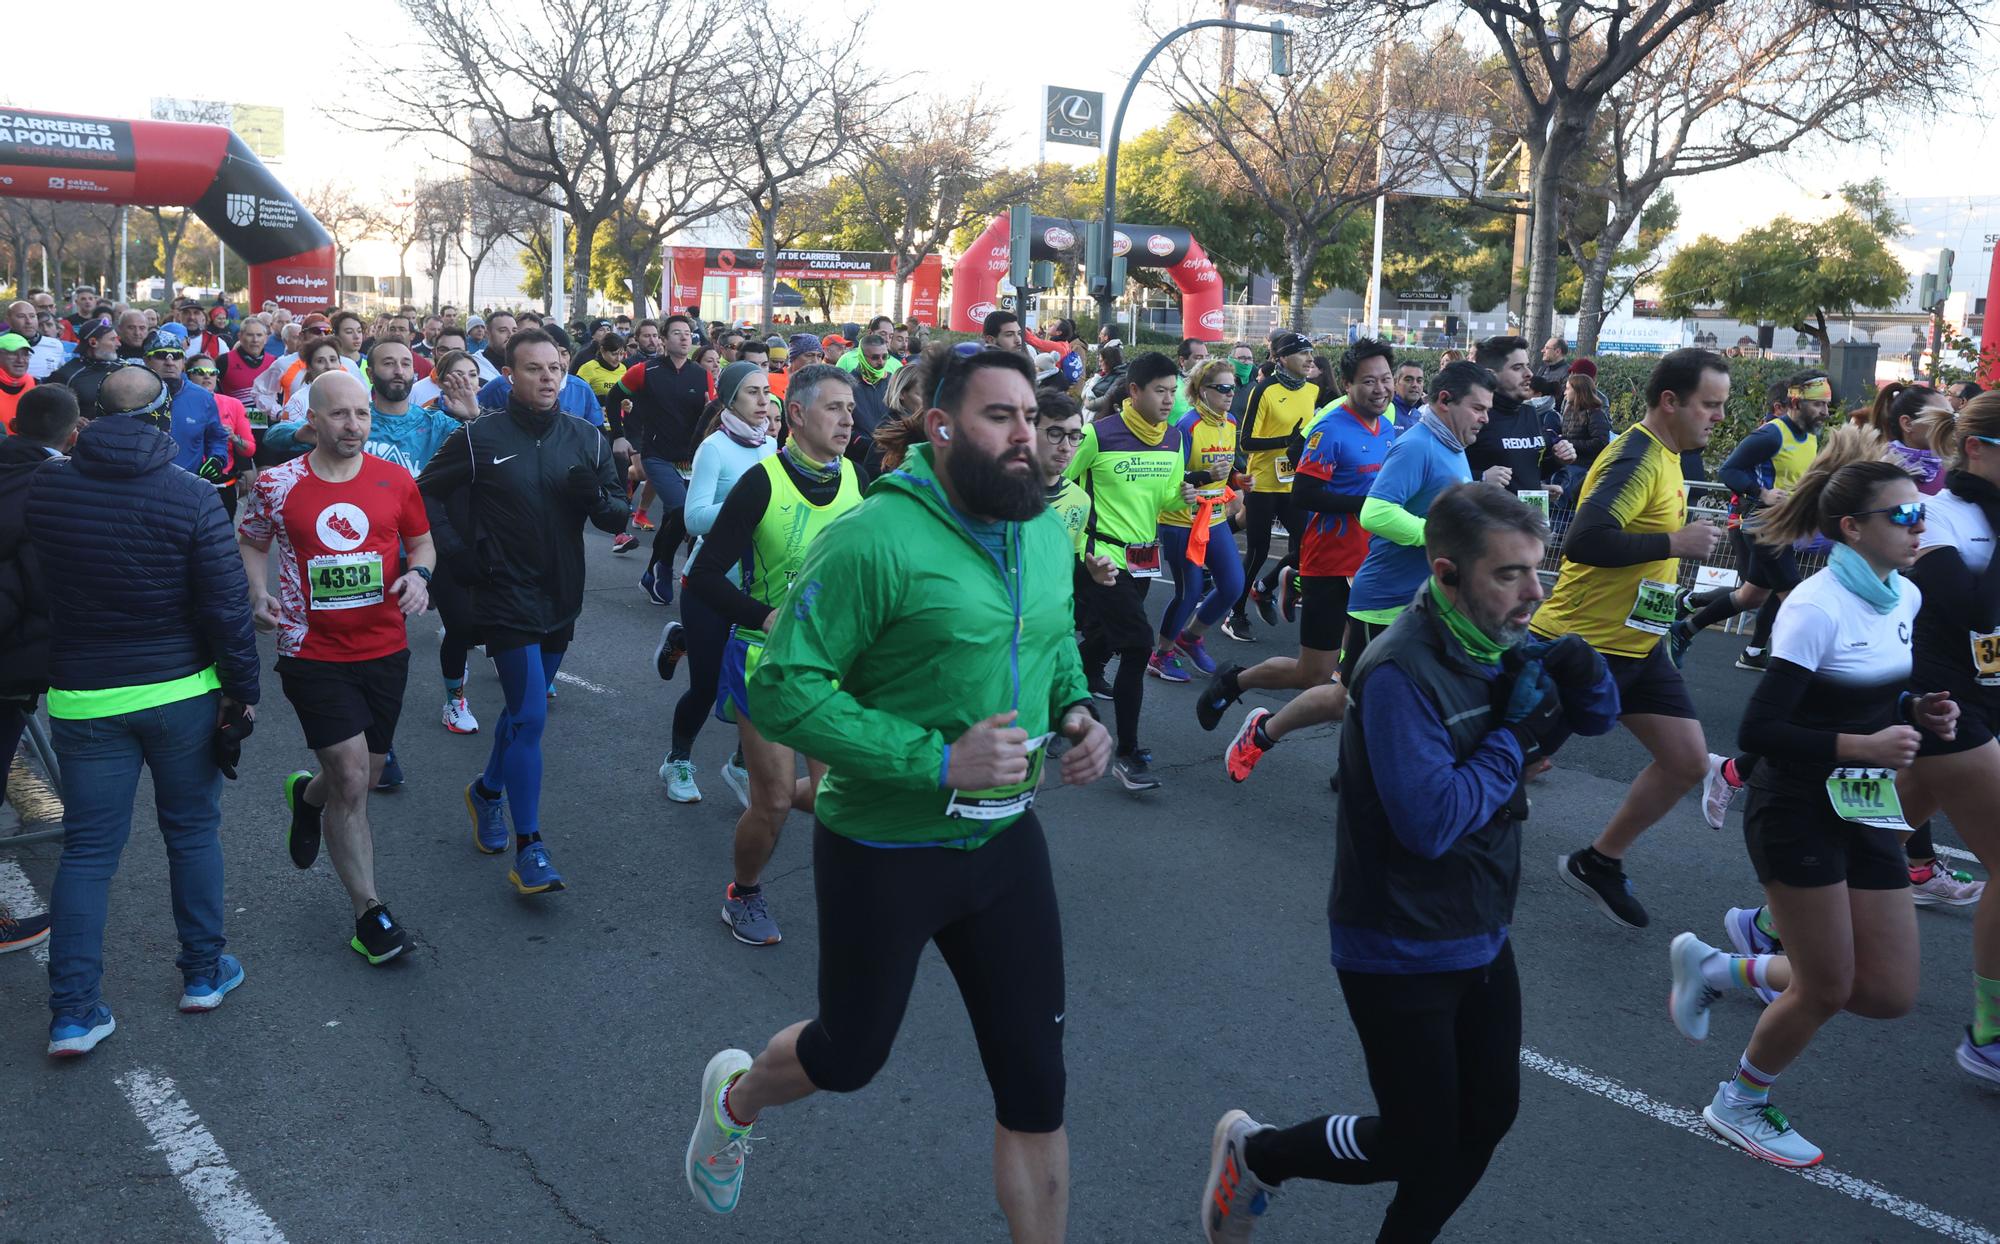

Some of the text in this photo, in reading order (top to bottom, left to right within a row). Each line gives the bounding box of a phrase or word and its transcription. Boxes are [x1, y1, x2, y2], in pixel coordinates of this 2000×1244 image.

[0, 115, 112, 136] CARRERES
[15, 129, 116, 151] POPULAR
[1051, 126, 1099, 140] LEXUS
[259, 213, 298, 223] Municipal
[788, 252, 799, 260] DE
[799, 253, 841, 261] CARRERES
[810, 260, 835, 269] CAIXA
[835, 262, 872, 270] POPULAR
[284, 295, 328, 304] INTERSPORT
[319, 565, 371, 589] 4338
[1841, 781, 1886, 808] 4472
